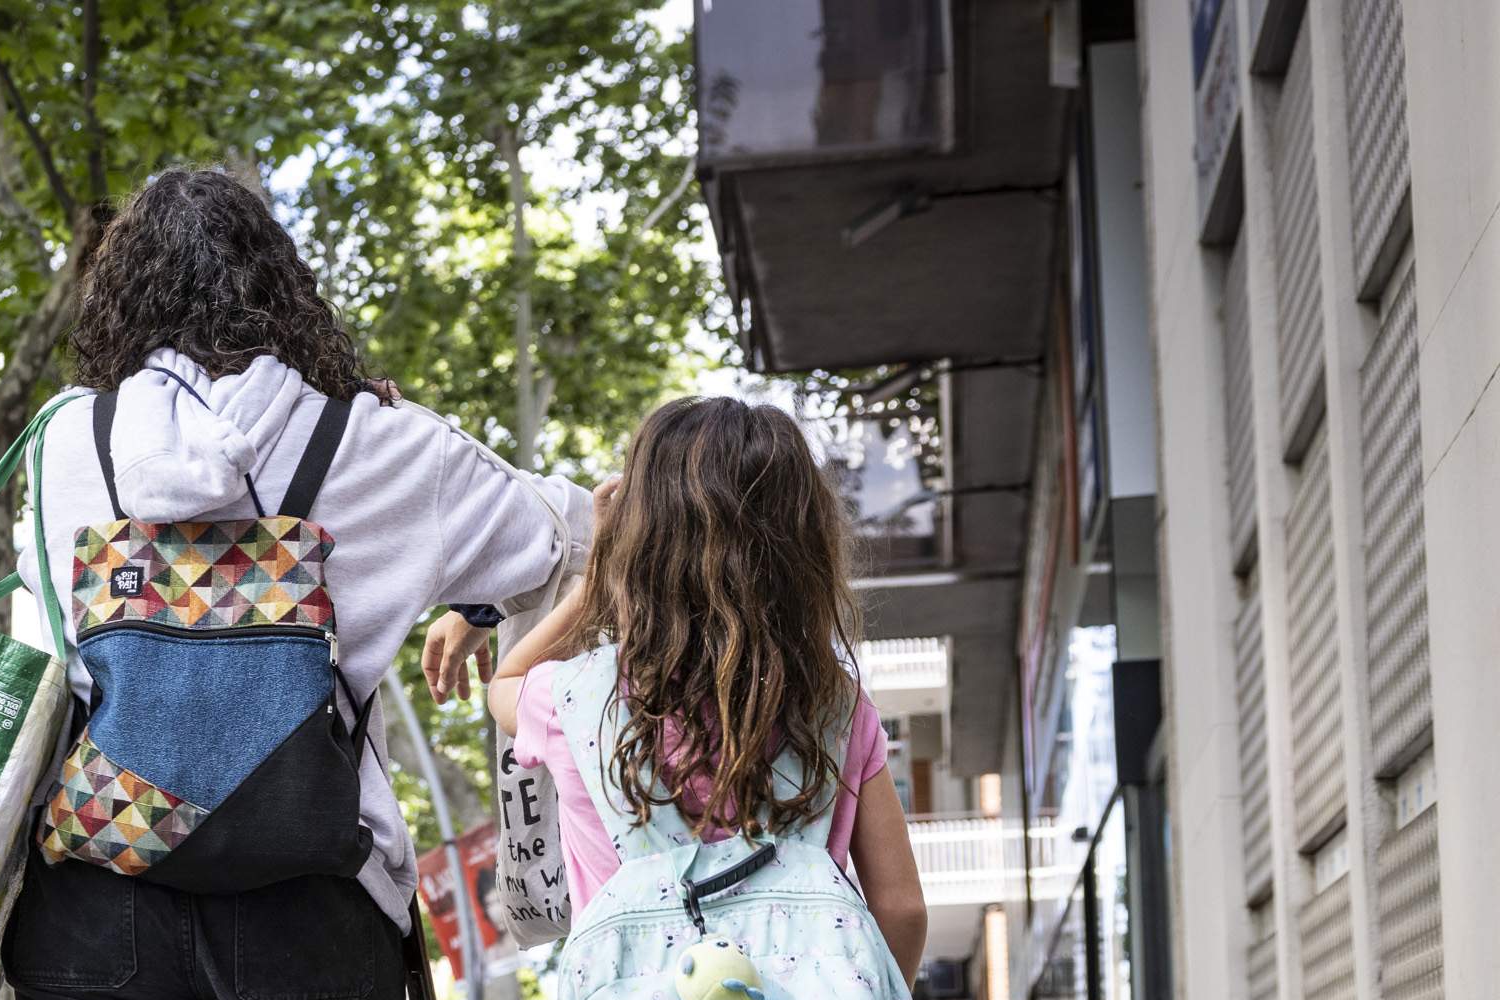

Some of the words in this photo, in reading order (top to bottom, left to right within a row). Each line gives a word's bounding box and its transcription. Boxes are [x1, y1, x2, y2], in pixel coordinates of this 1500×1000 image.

[118, 580, 137, 590] PAM
[508, 837, 545, 862] the
[505, 875, 528, 898] my
[507, 900, 545, 921] and
